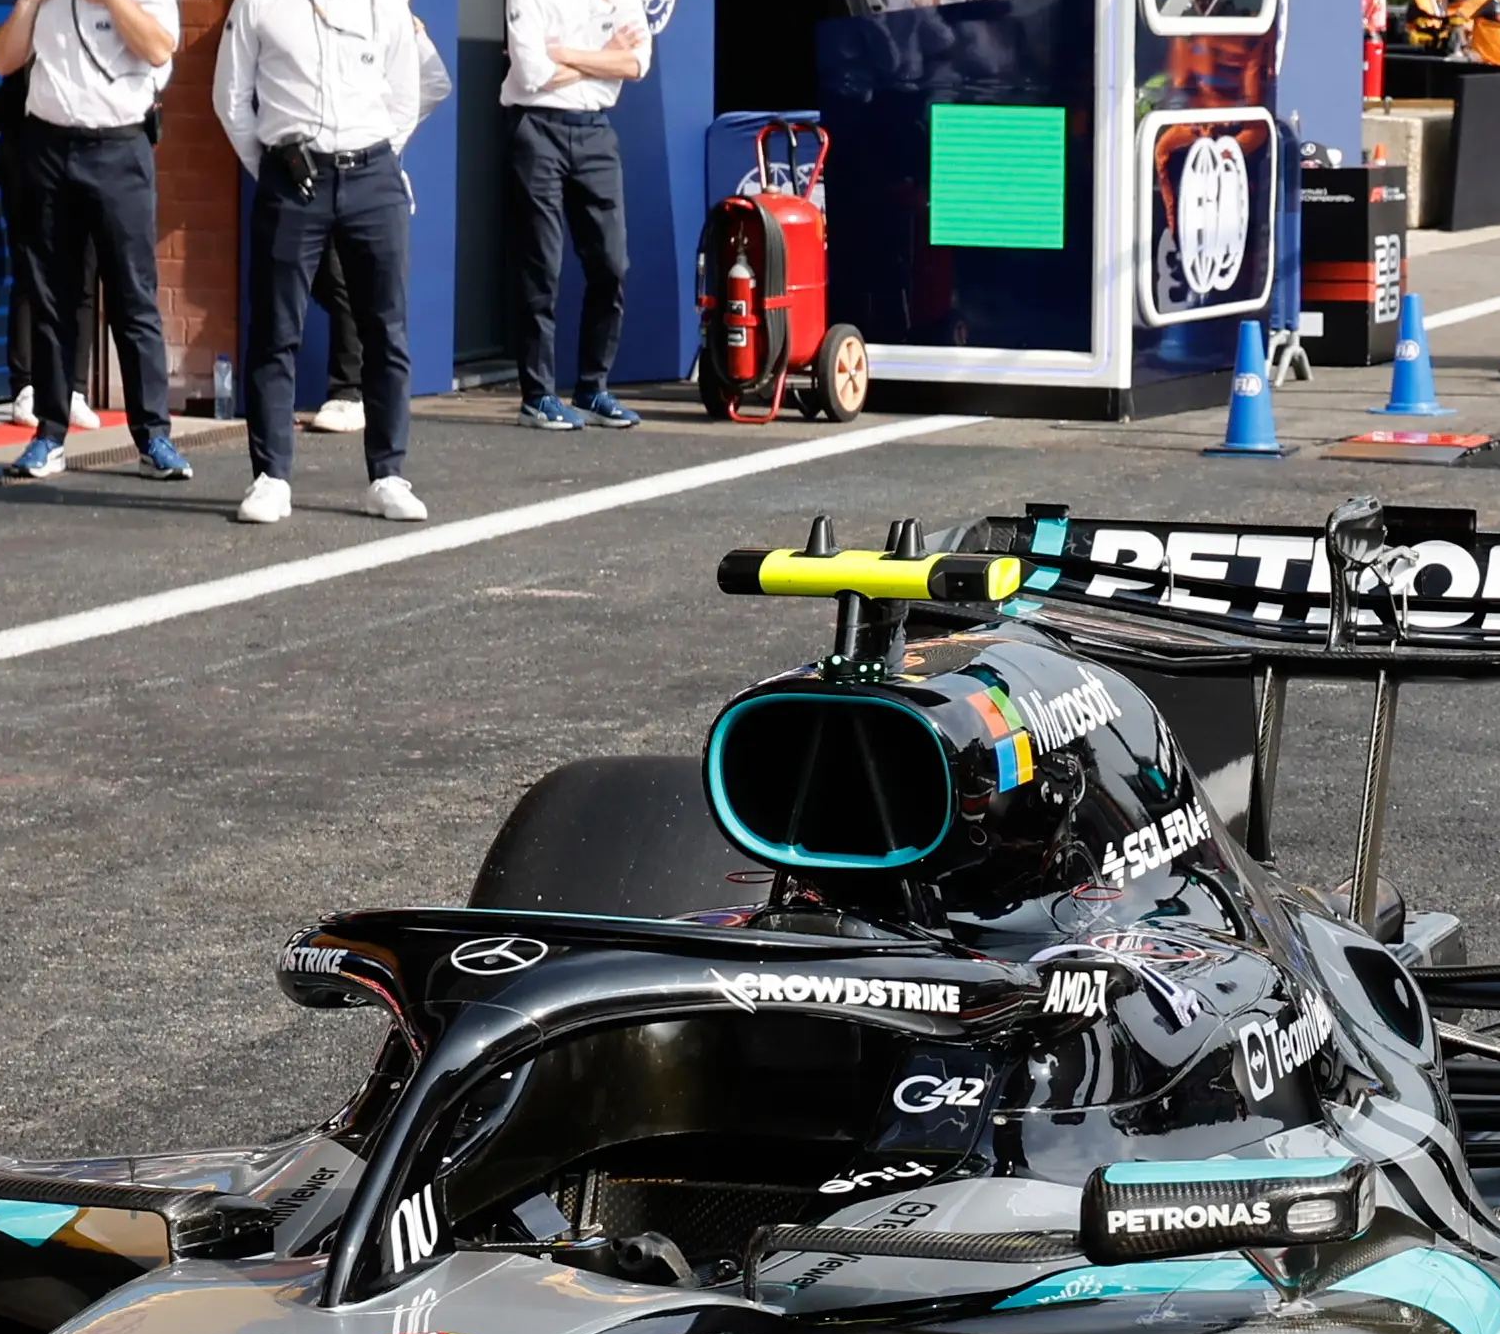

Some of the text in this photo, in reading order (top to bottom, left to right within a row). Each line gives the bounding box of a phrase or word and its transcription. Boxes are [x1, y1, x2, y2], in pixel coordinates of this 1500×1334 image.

[1019, 667, 1122, 756] Microsoft
[1122, 800, 1203, 880] SOLERA
[1043, 970, 1094, 1015] AMD
[894, 1074, 985, 1115] G42
[1107, 1200, 1272, 1234] PETRONAS
